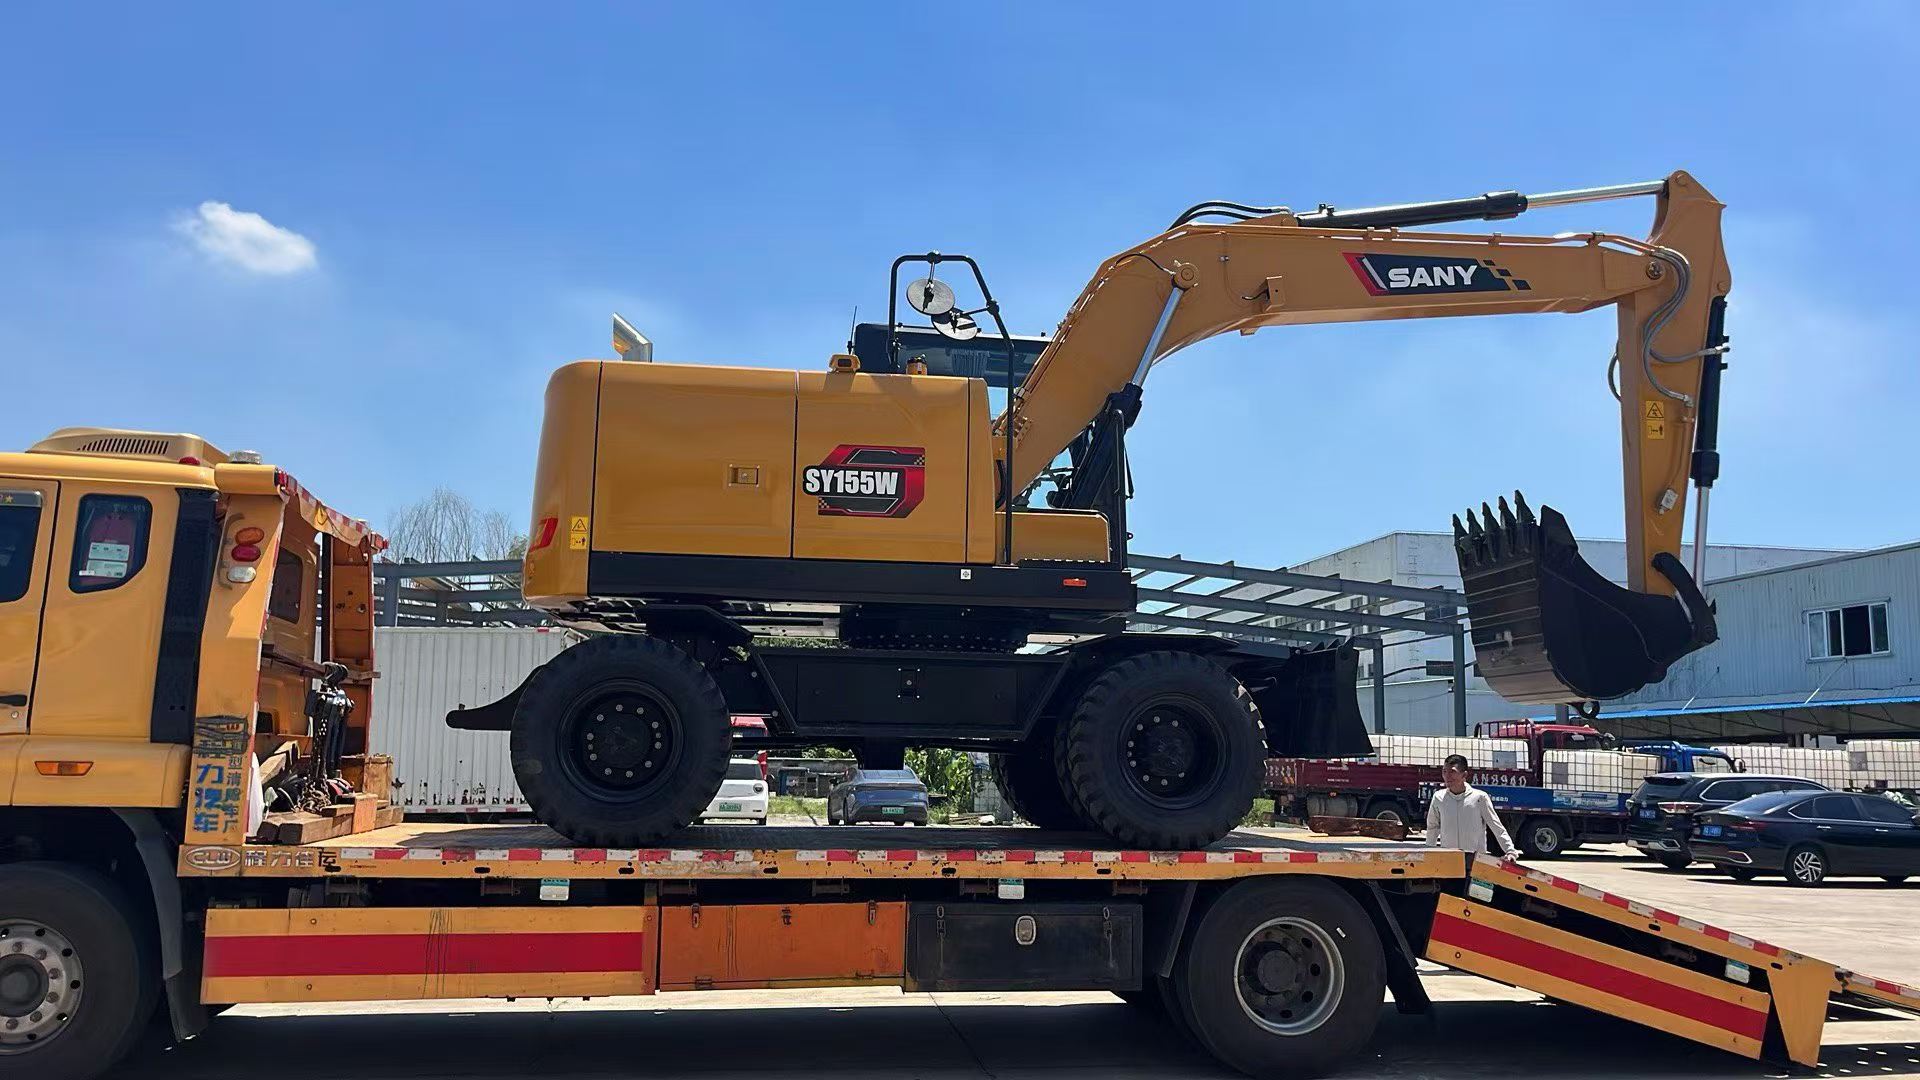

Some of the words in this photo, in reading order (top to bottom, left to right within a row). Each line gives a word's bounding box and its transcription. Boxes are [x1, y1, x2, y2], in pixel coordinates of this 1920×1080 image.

[1388, 265, 1478, 289] SANY
[805, 468, 899, 495] SY155W
[192, 851, 231, 865] CLW
